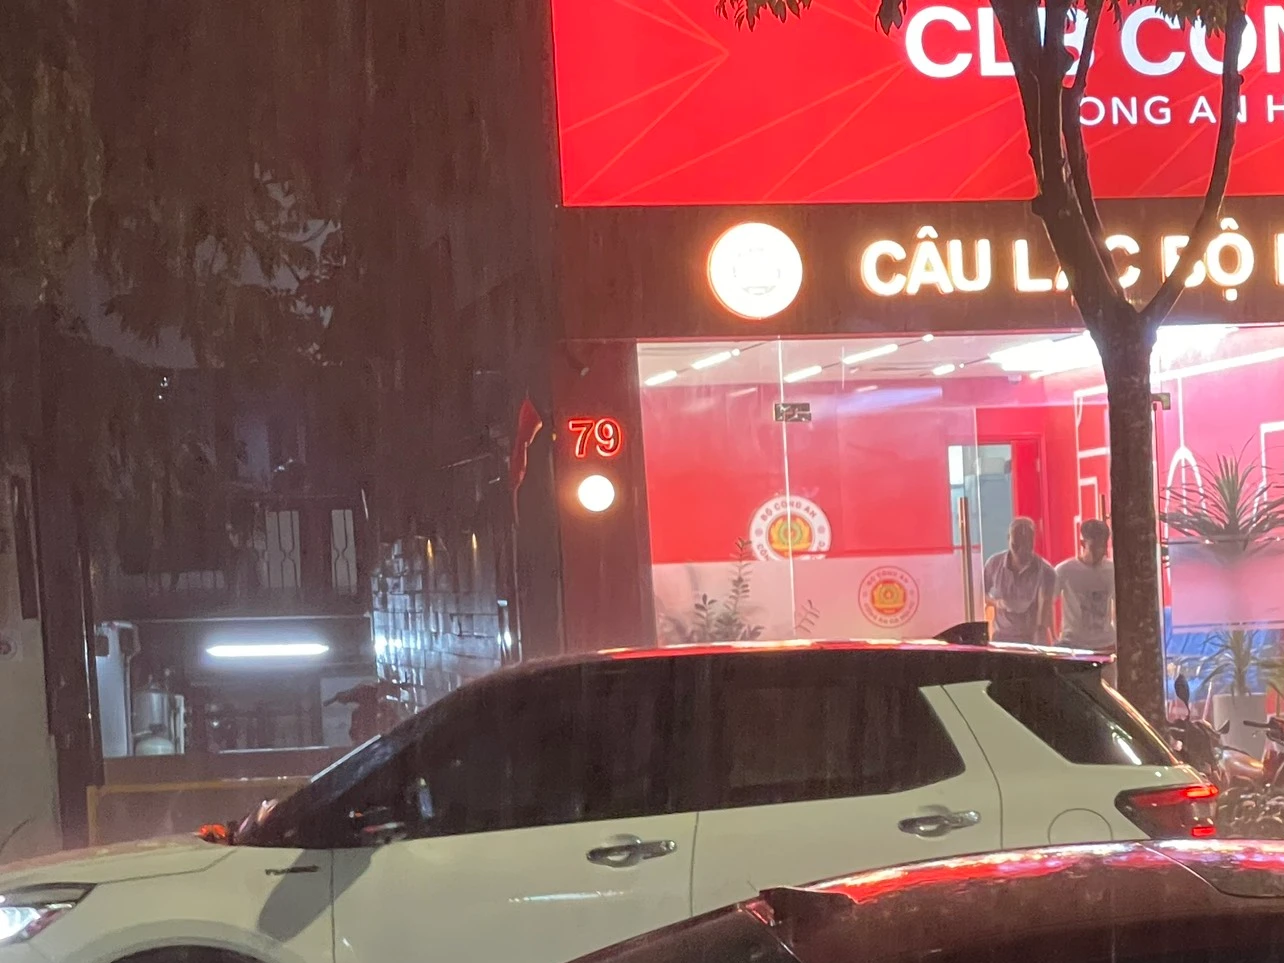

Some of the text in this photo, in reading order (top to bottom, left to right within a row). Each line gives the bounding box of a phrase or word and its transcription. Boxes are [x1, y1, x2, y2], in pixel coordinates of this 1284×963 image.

[1079, 95, 1171, 126] ONG
[861, 225, 991, 296] CÂU
[1013, 234, 1141, 293] LC
[569, 418, 622, 457] 79
